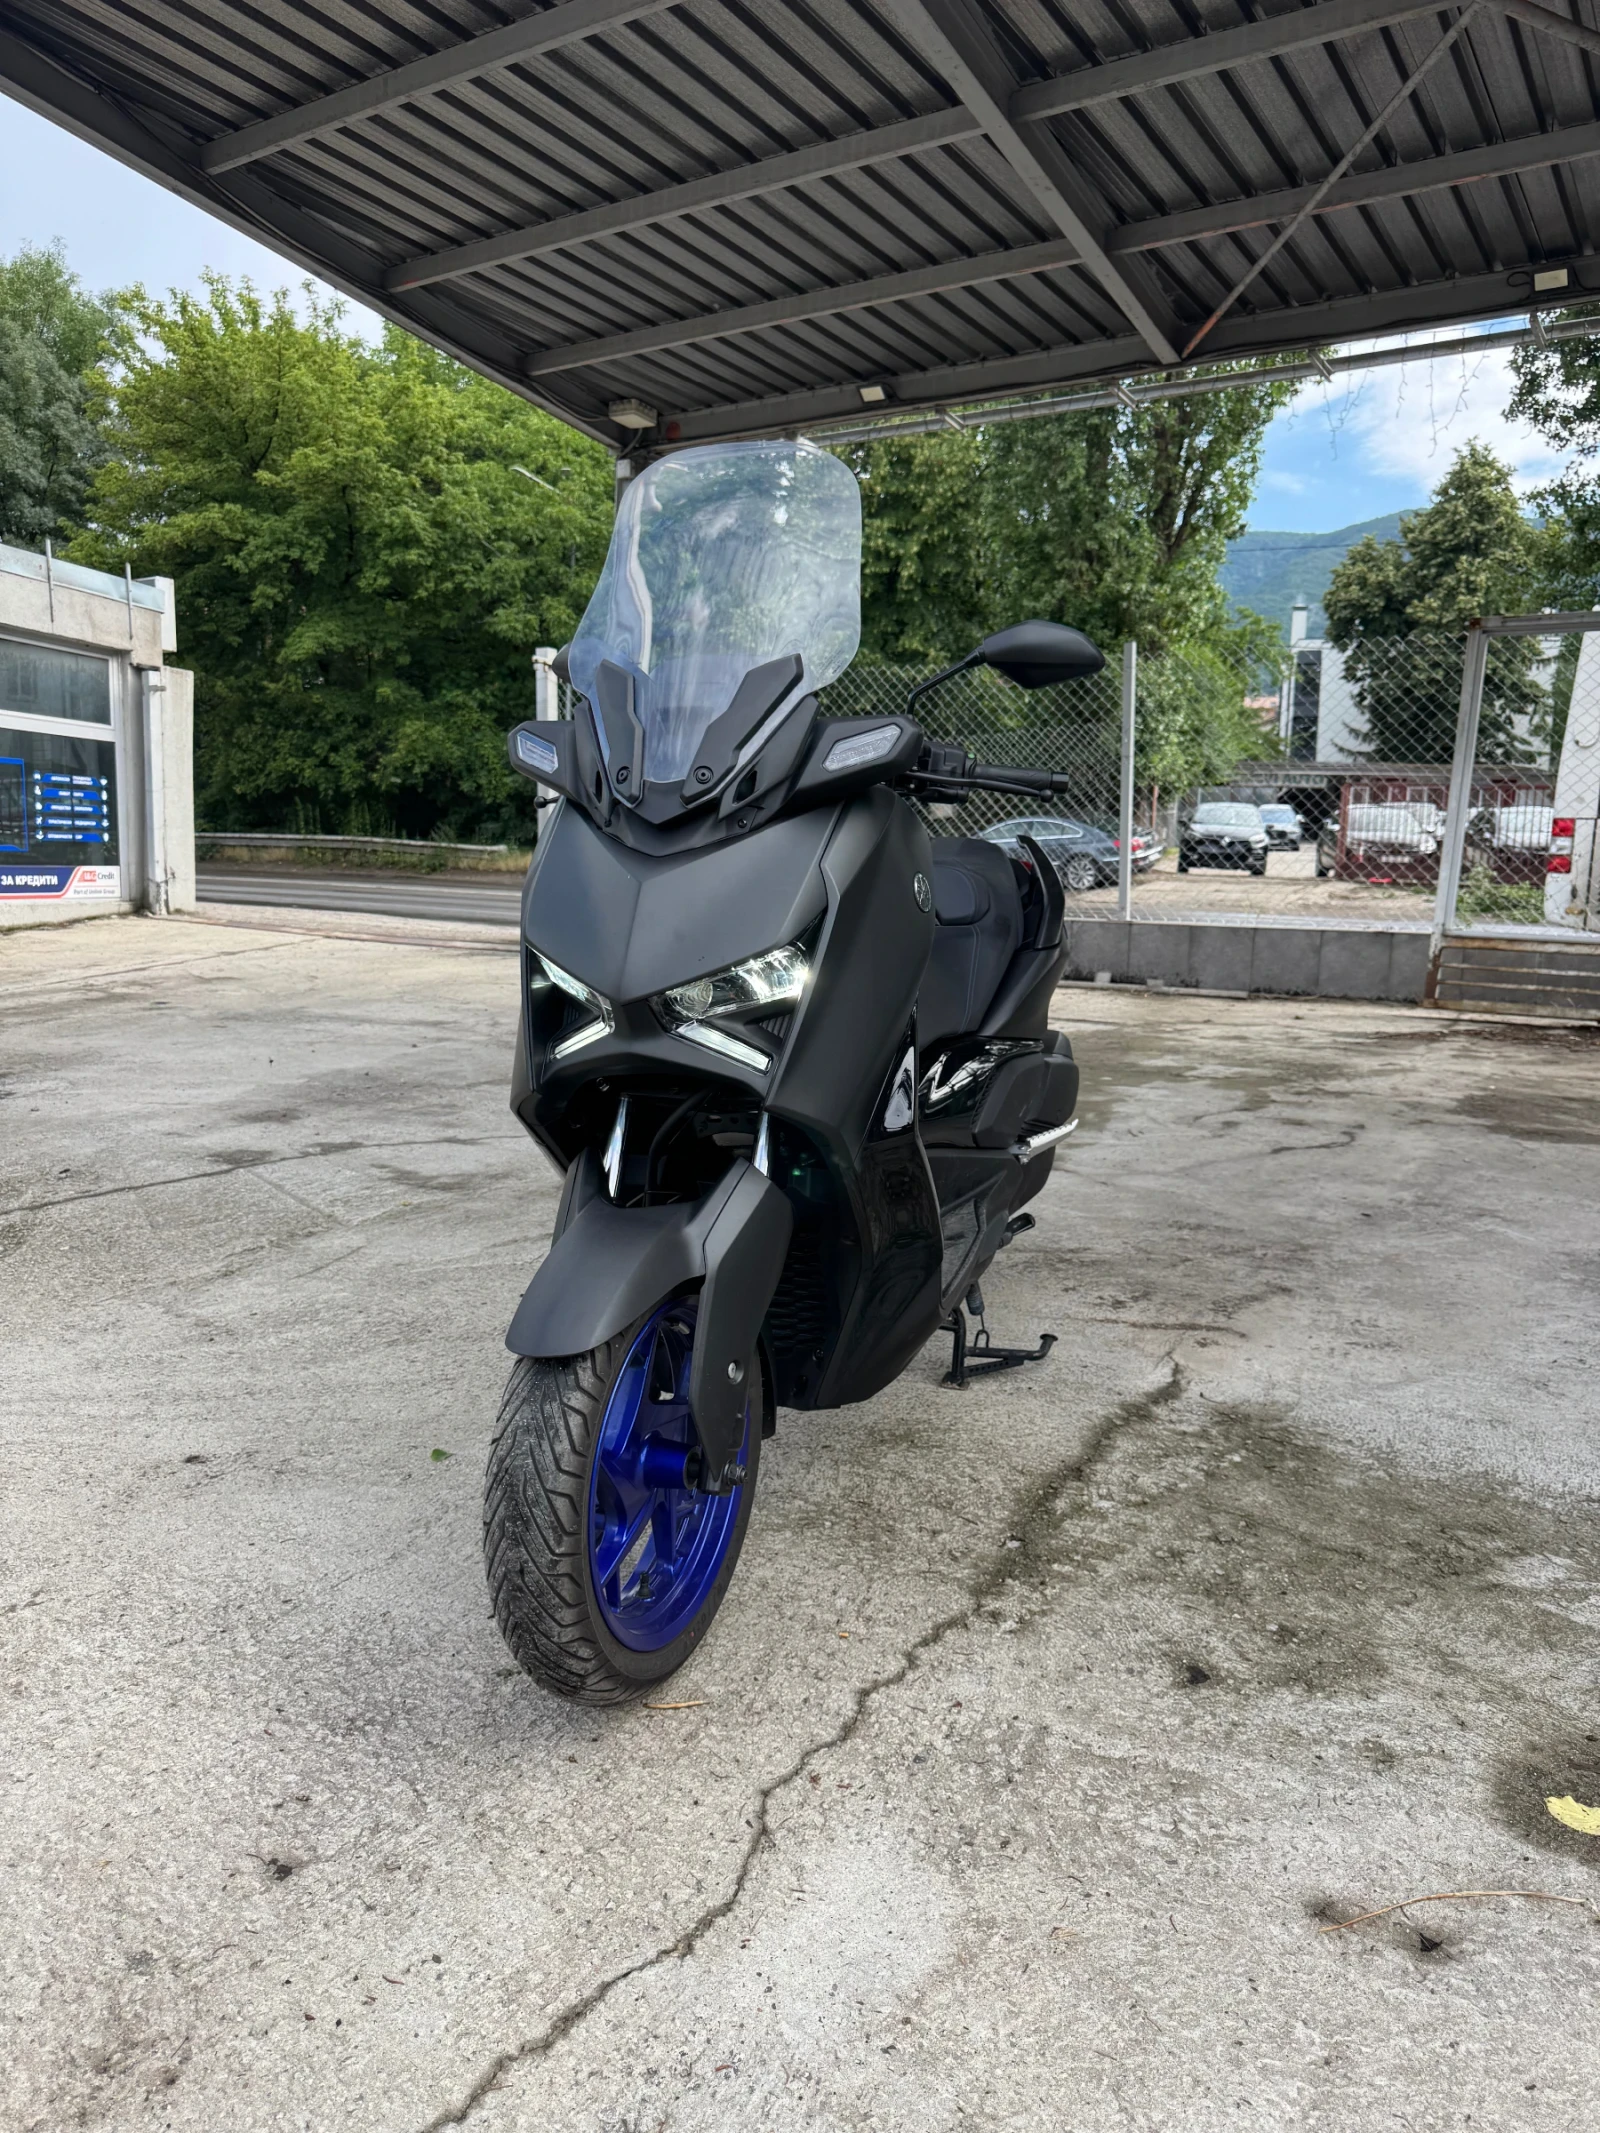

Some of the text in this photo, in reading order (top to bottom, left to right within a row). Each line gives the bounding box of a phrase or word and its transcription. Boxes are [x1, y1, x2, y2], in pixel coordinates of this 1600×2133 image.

[1, 875, 58, 886] ЗА КРЕДИТИ
[97, 871, 115, 880] Credit
